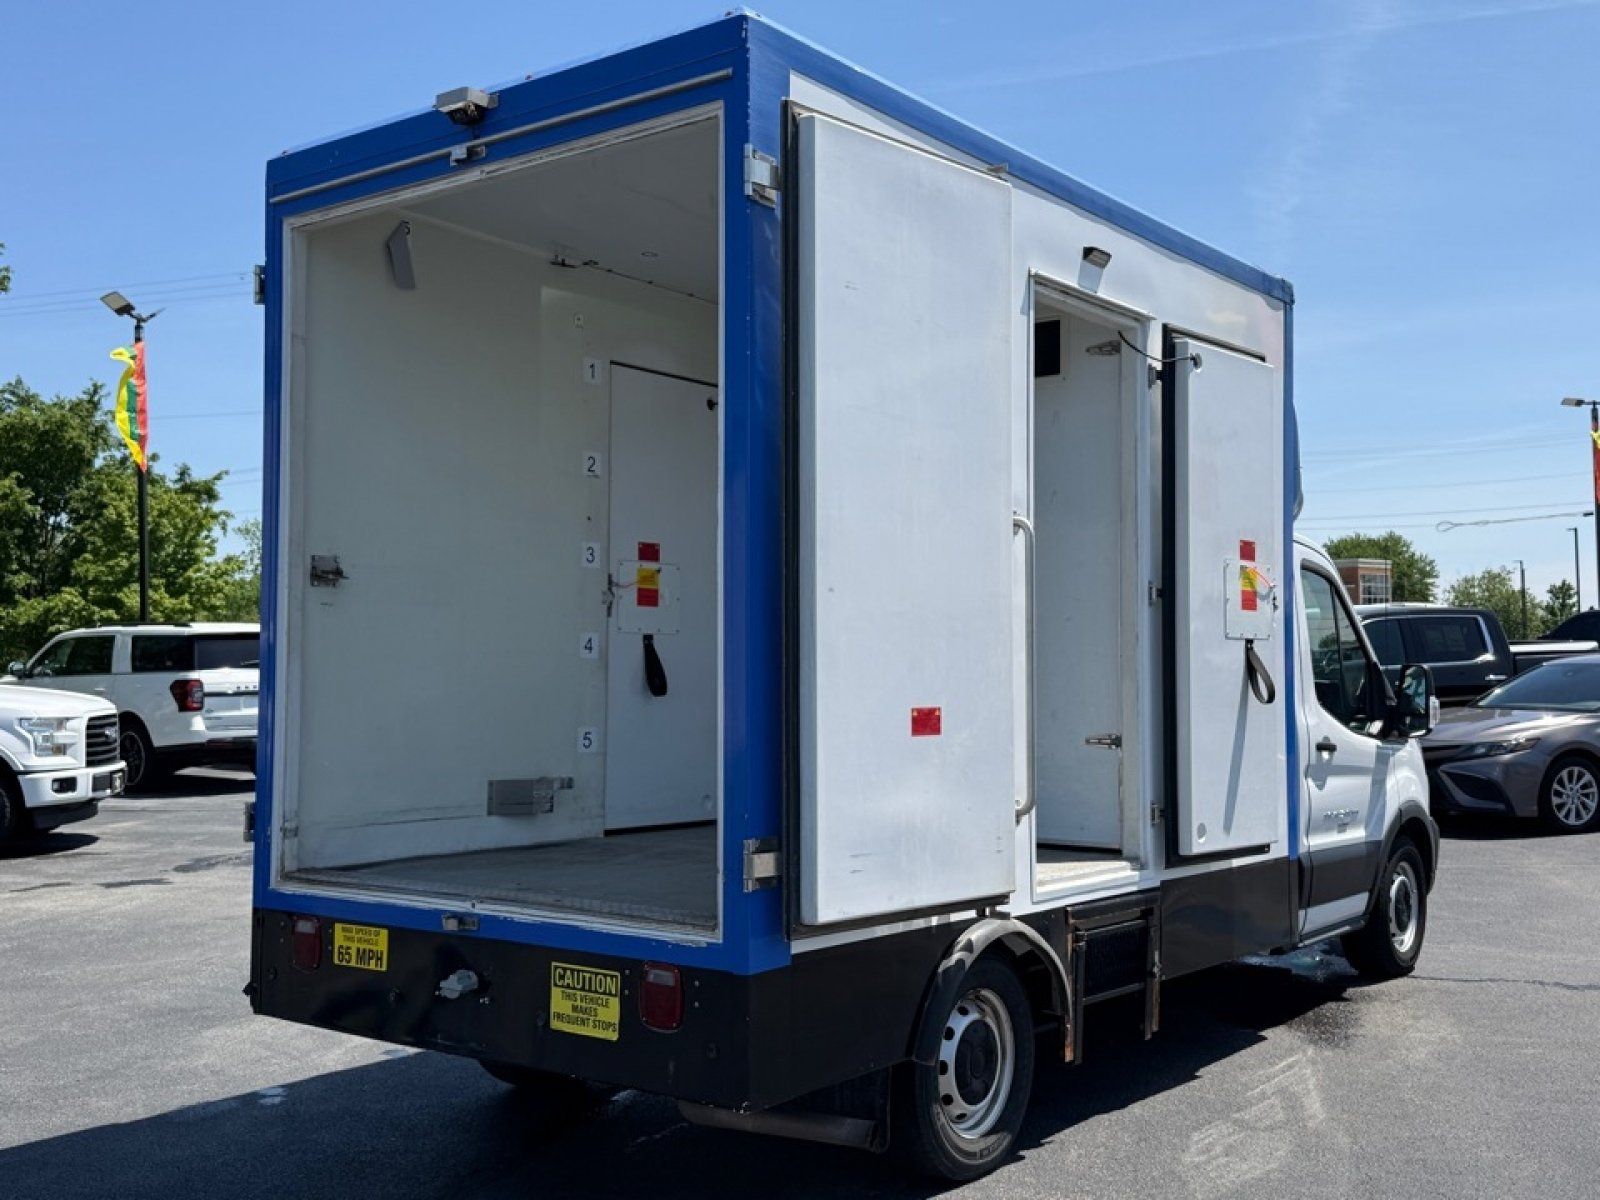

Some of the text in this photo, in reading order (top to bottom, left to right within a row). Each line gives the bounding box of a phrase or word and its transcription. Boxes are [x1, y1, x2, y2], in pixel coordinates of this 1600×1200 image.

[588, 363, 596, 380] 1
[587, 456, 596, 473] 2
[586, 546, 596, 564] 3
[584, 637, 594, 655] 4
[582, 731, 593, 750] 5
[337, 944, 384, 969] 65 MPH
[553, 967, 617, 995] CAUTION
[561, 990, 610, 1009] THIS VEHICLE
[571, 1003, 599, 1018] MAKES
[553, 1011, 617, 1032] FREQUENT STOPS
